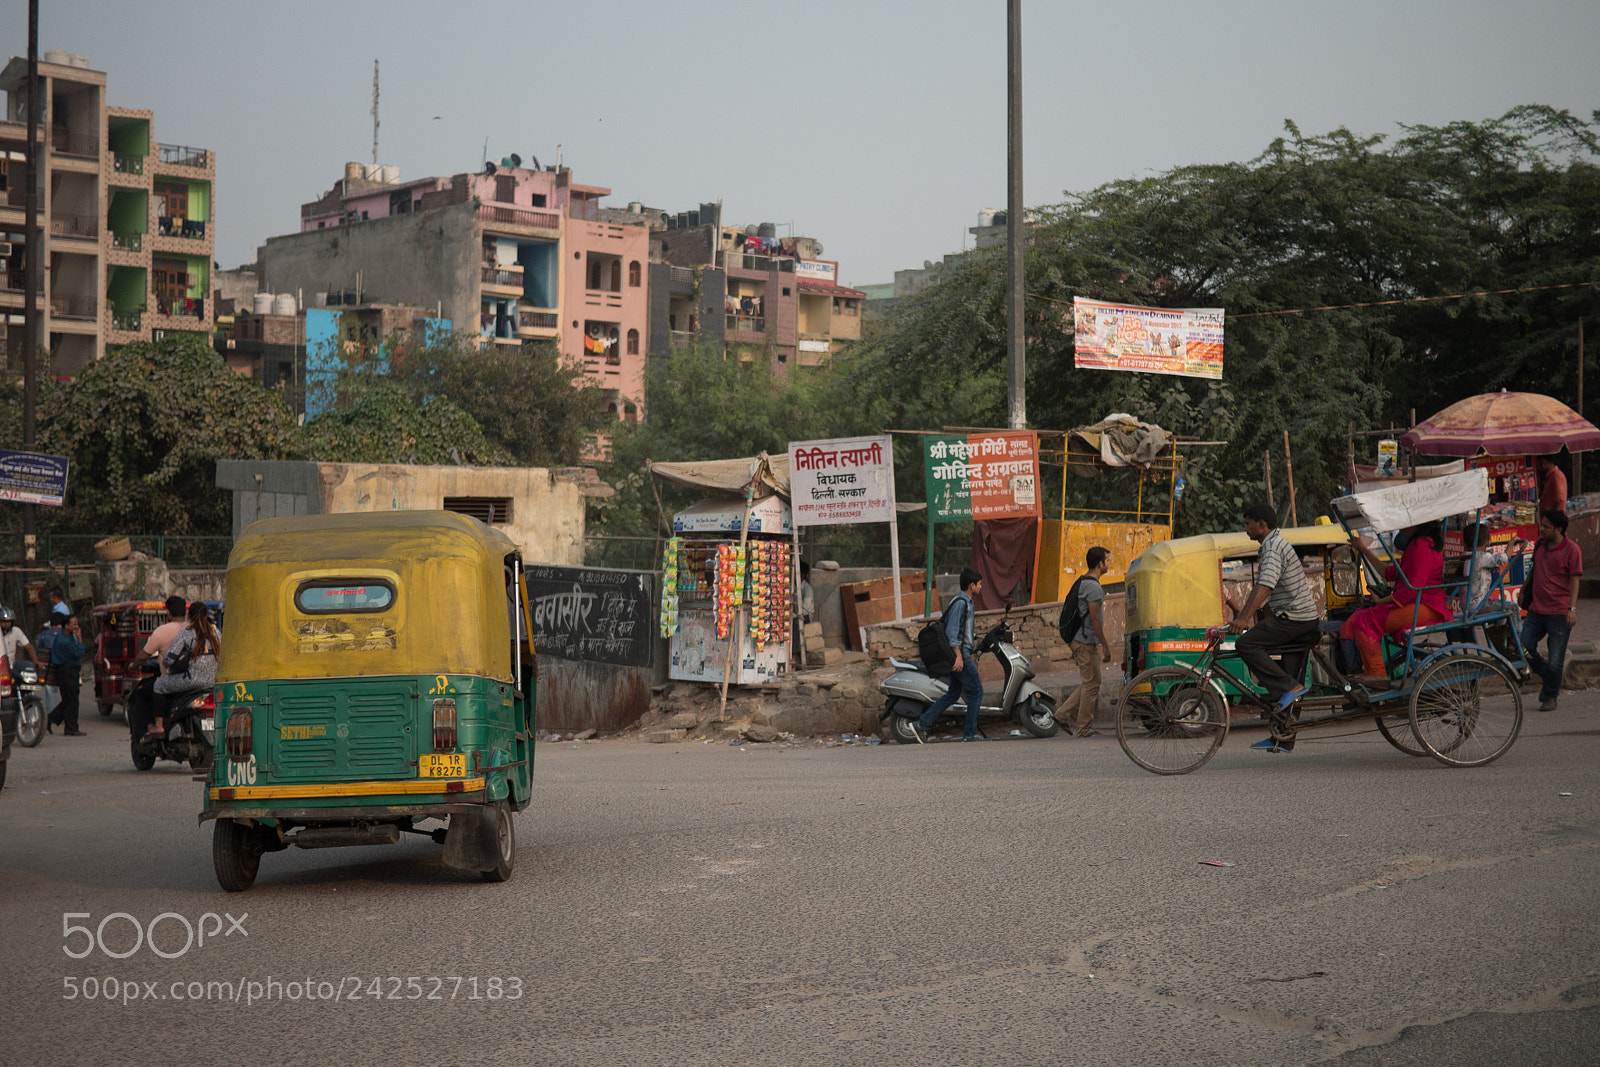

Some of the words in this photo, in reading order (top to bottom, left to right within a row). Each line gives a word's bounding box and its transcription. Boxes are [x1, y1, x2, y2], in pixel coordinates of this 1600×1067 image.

[930, 441, 947, 459] श्री
[948, 440, 979, 460] महेश
[980, 438, 1007, 456] गिरी
[795, 447, 838, 471] नितिन
[840, 442, 882, 467] त्यागी
[932, 460, 983, 480] गोविन्द
[986, 460, 1034, 477] अग्रवाल
[1496, 461, 1525, 475] 99/-
[816, 472, 857, 486] विधायक
[961, 479, 985, 489] निगम
[811, 486, 835, 500] दिल्ली
[838, 488, 867, 499] सरकार
[535, 582, 598, 635] बवासीर
[281, 726, 310, 740] SETHI
[430, 755, 443, 765] DL
[448, 755, 460, 765] 1R
[228, 754, 257, 786] CNG
[429, 766, 462, 777] K8276
